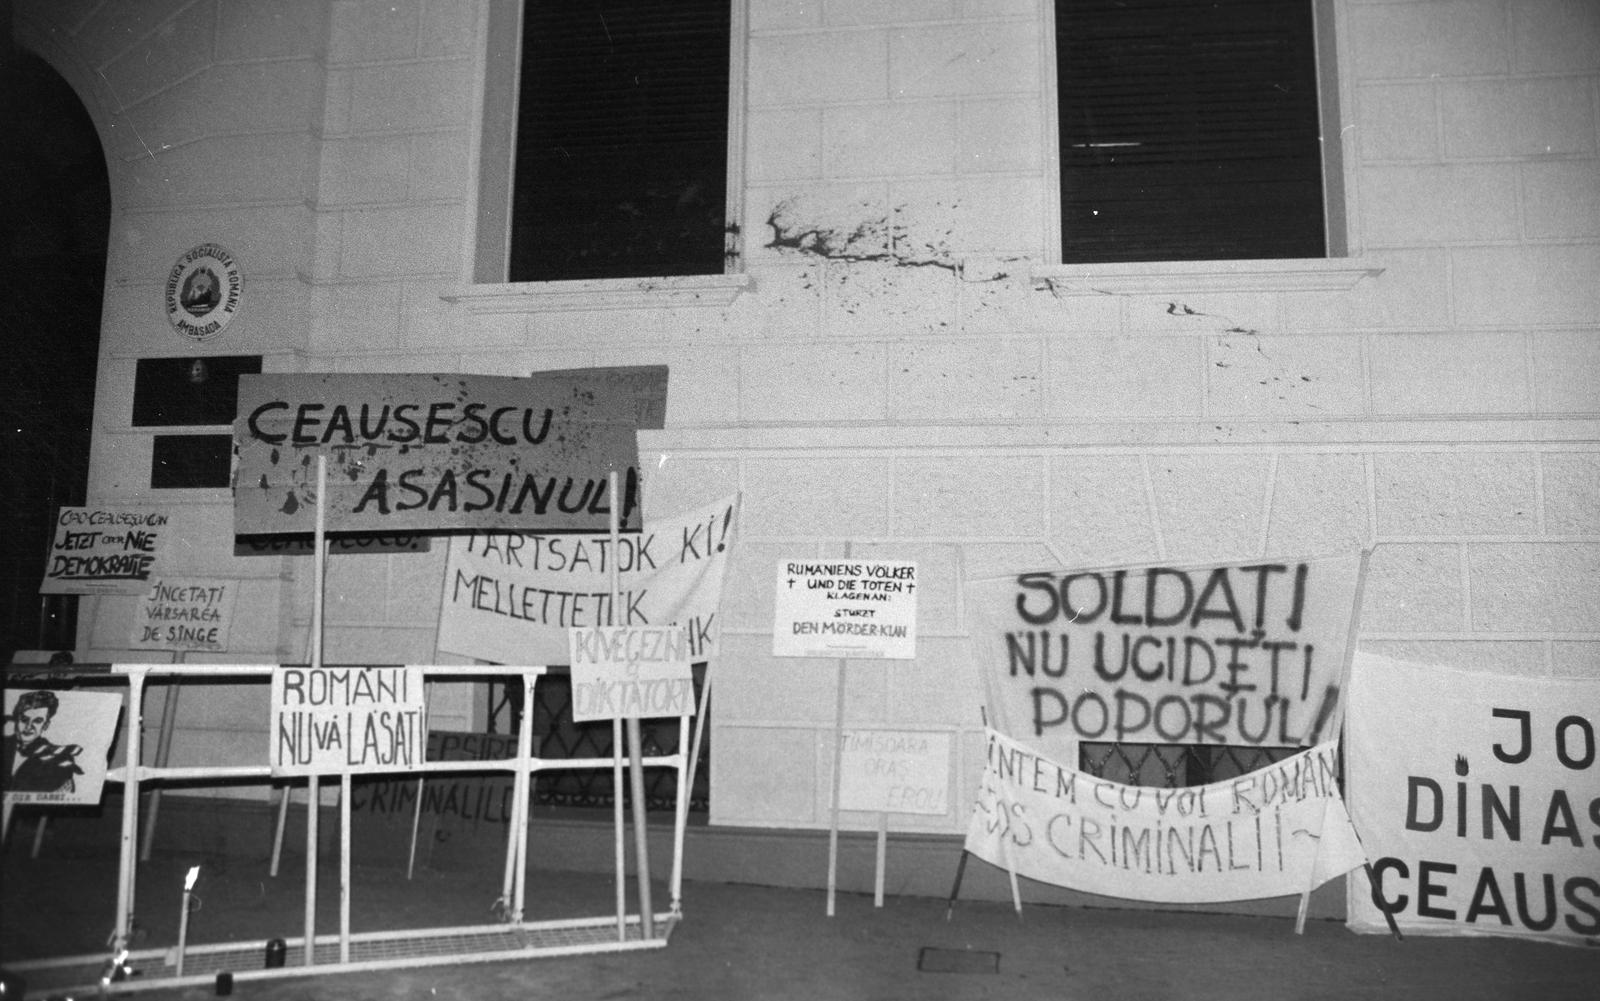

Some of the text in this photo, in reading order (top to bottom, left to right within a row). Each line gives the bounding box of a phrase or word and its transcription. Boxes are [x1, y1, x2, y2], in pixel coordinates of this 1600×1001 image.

[167, 264, 185, 314] REPUBLICA
[177, 319, 221, 336] AMBASADA
[353, 466, 638, 527] ASASINUL!
[55, 531, 102, 550] JETZT
[124, 531, 157, 551] NIE
[50, 554, 155, 577] DEMOKRATIE
[807, 579, 903, 593] UND DIE TOTEN
[140, 626, 159, 643] DE
[793, 622, 818, 636] DEN
[1006, 630, 1068, 678] NU
[1031, 684, 1339, 744] POPORUL!
[279, 711, 313, 766] NU
[1492, 707, 1596, 770] JO
[1095, 783, 1142, 810] CU
[1405, 760, 1600, 850] DINA
